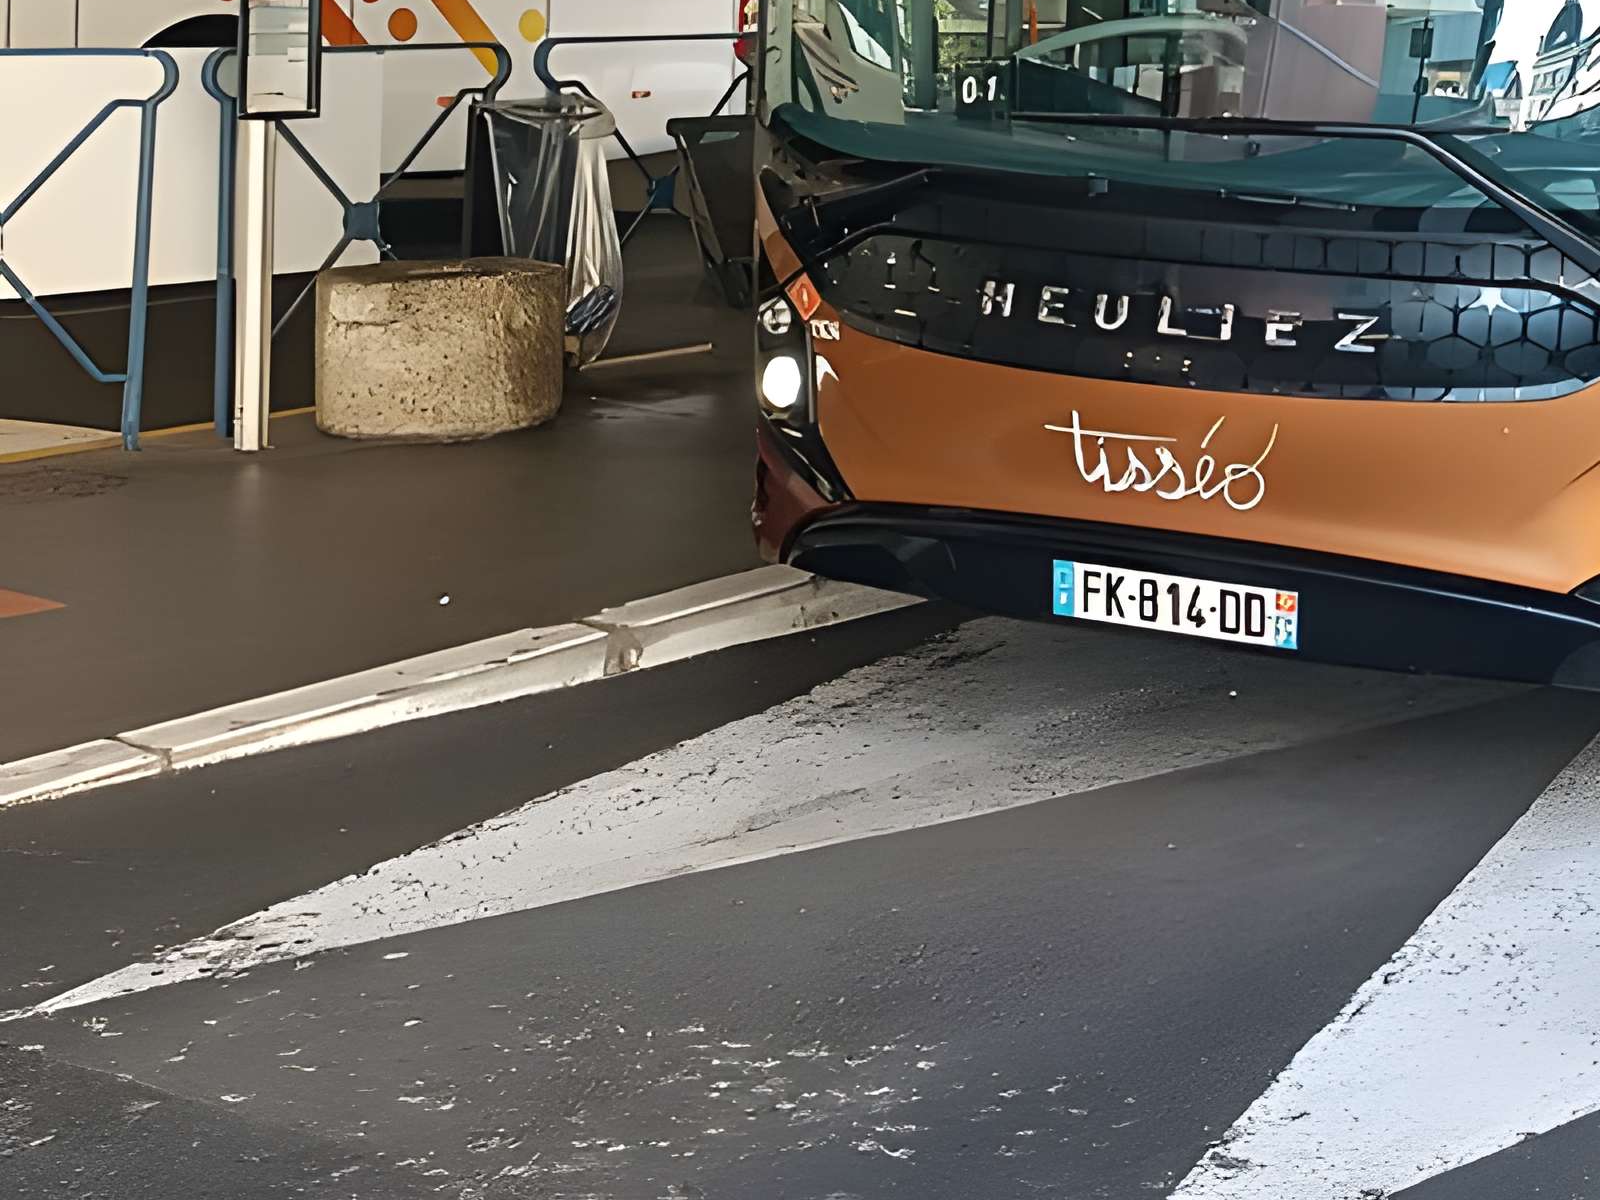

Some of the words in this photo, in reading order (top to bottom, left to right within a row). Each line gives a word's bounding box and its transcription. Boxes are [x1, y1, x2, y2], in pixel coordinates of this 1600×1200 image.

[979, 280, 1380, 353] HEULIEZ
[1044, 409, 1279, 511] tisséo
[1083, 569, 1266, 638] FK-814-DD
